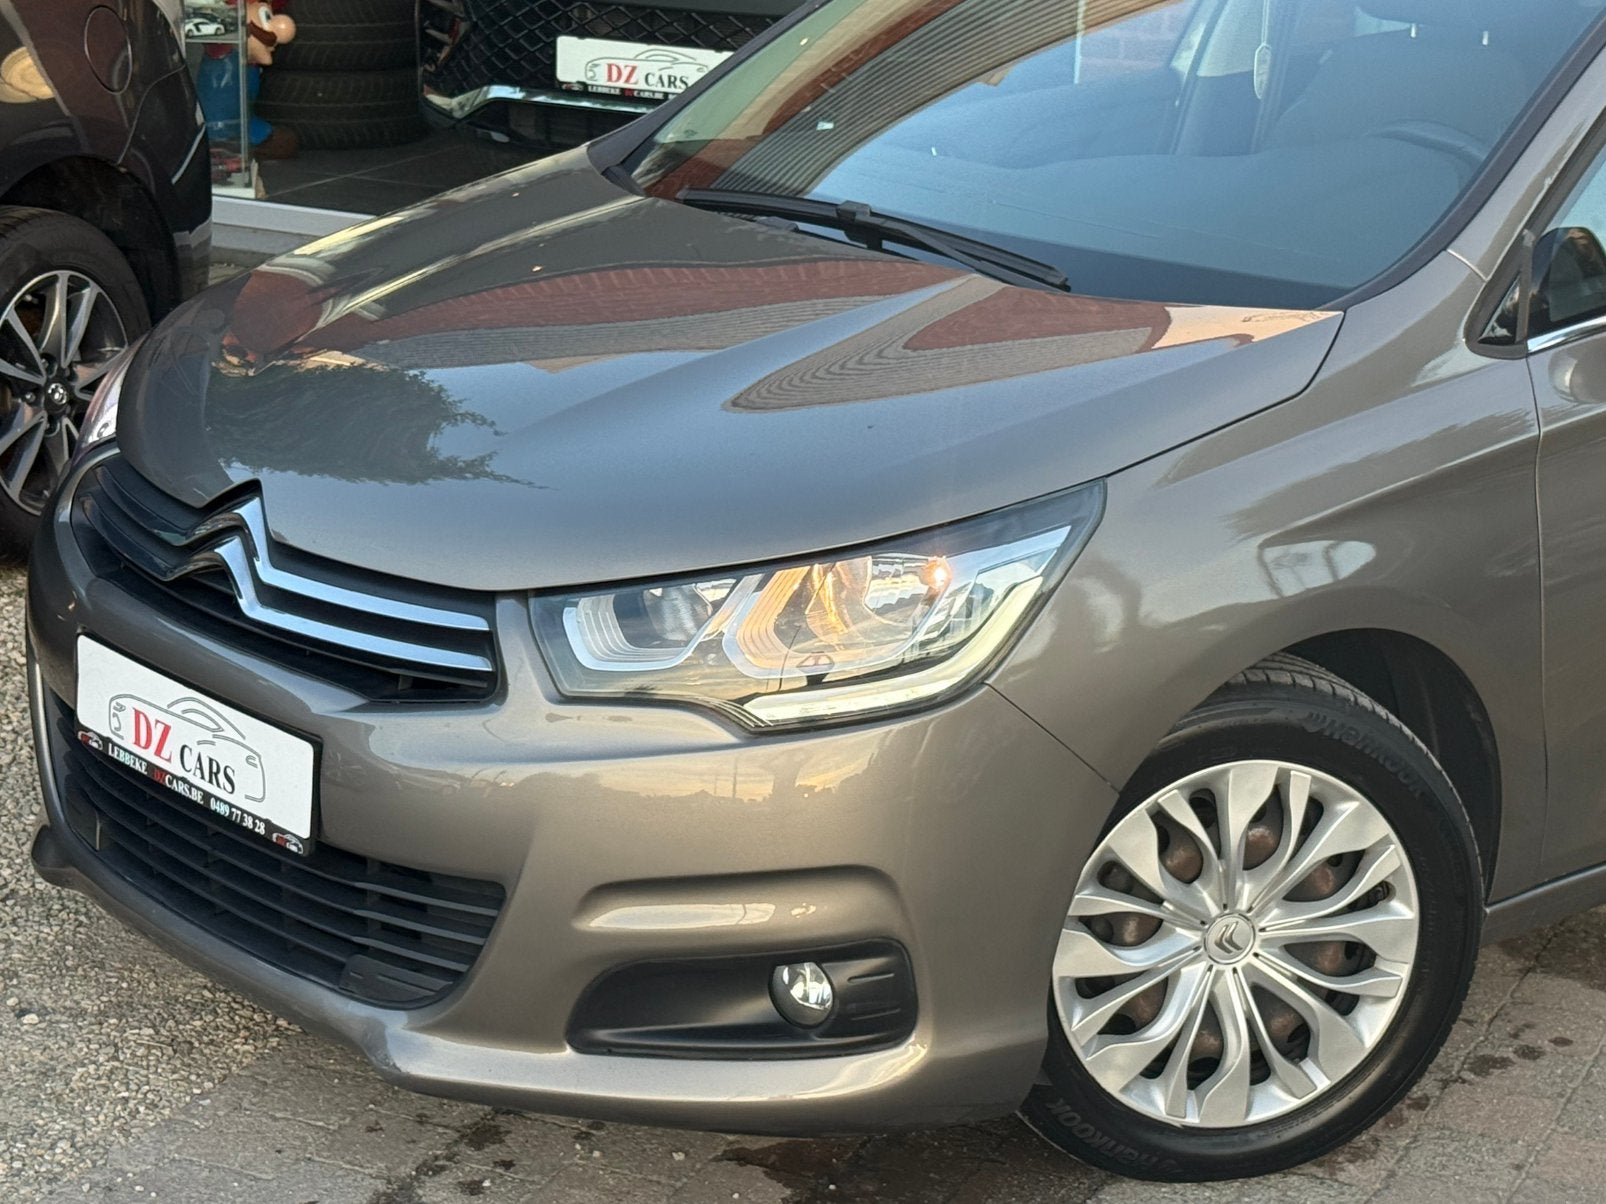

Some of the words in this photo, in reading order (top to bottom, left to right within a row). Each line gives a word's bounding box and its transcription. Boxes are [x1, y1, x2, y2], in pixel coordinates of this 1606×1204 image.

[606, 63, 639, 85] DZ
[644, 72, 689, 90] CARS
[108, 742, 148, 775] LEBBEKE
[153, 767, 204, 805] DZCARS.BE
[210, 797, 230, 817] 0489
[231, 808, 242, 823] 77
[242, 813, 253, 830] 38
[254, 819, 266, 836] 28
[132, 707, 172, 764] DZ
[179, 744, 236, 796] CARS
